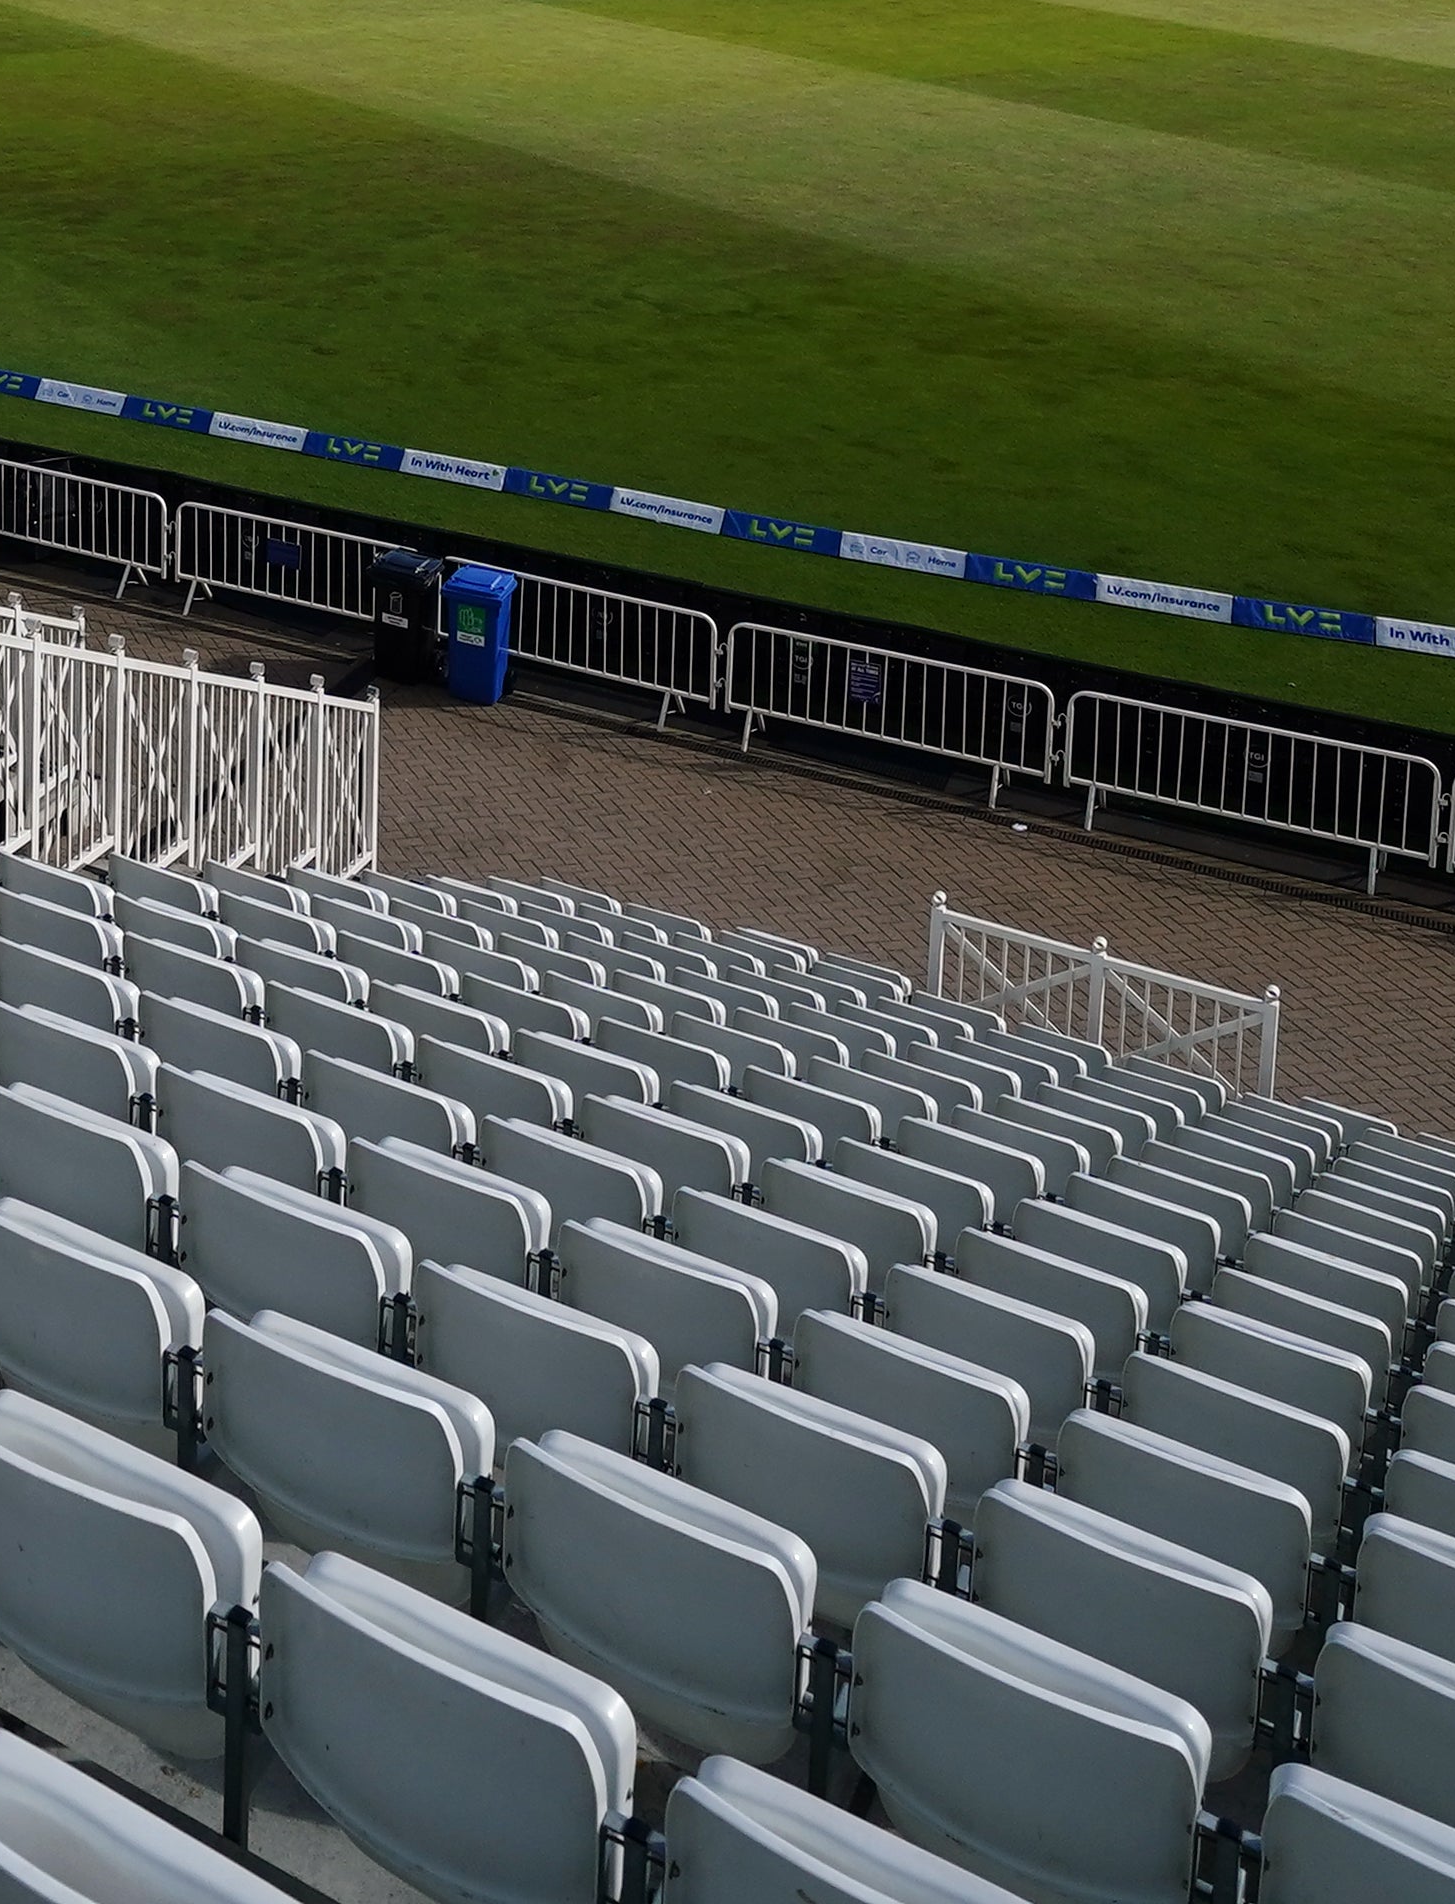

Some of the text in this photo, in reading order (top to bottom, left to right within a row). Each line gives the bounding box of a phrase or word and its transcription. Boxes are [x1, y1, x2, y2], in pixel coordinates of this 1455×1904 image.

[96, 398, 118, 408] Home
[219, 421, 298, 444] LV.com/insurance
[410, 456, 490, 481] In With Heart
[620, 497, 713, 525] LV.com/insurance
[869, 545, 957, 568] Car Home
[1107, 585, 1221, 612] LV.com/insurance
[1390, 627, 1403, 638] In
[1410, 629, 1450, 646] With
[1249, 751, 1265, 762] TGI
